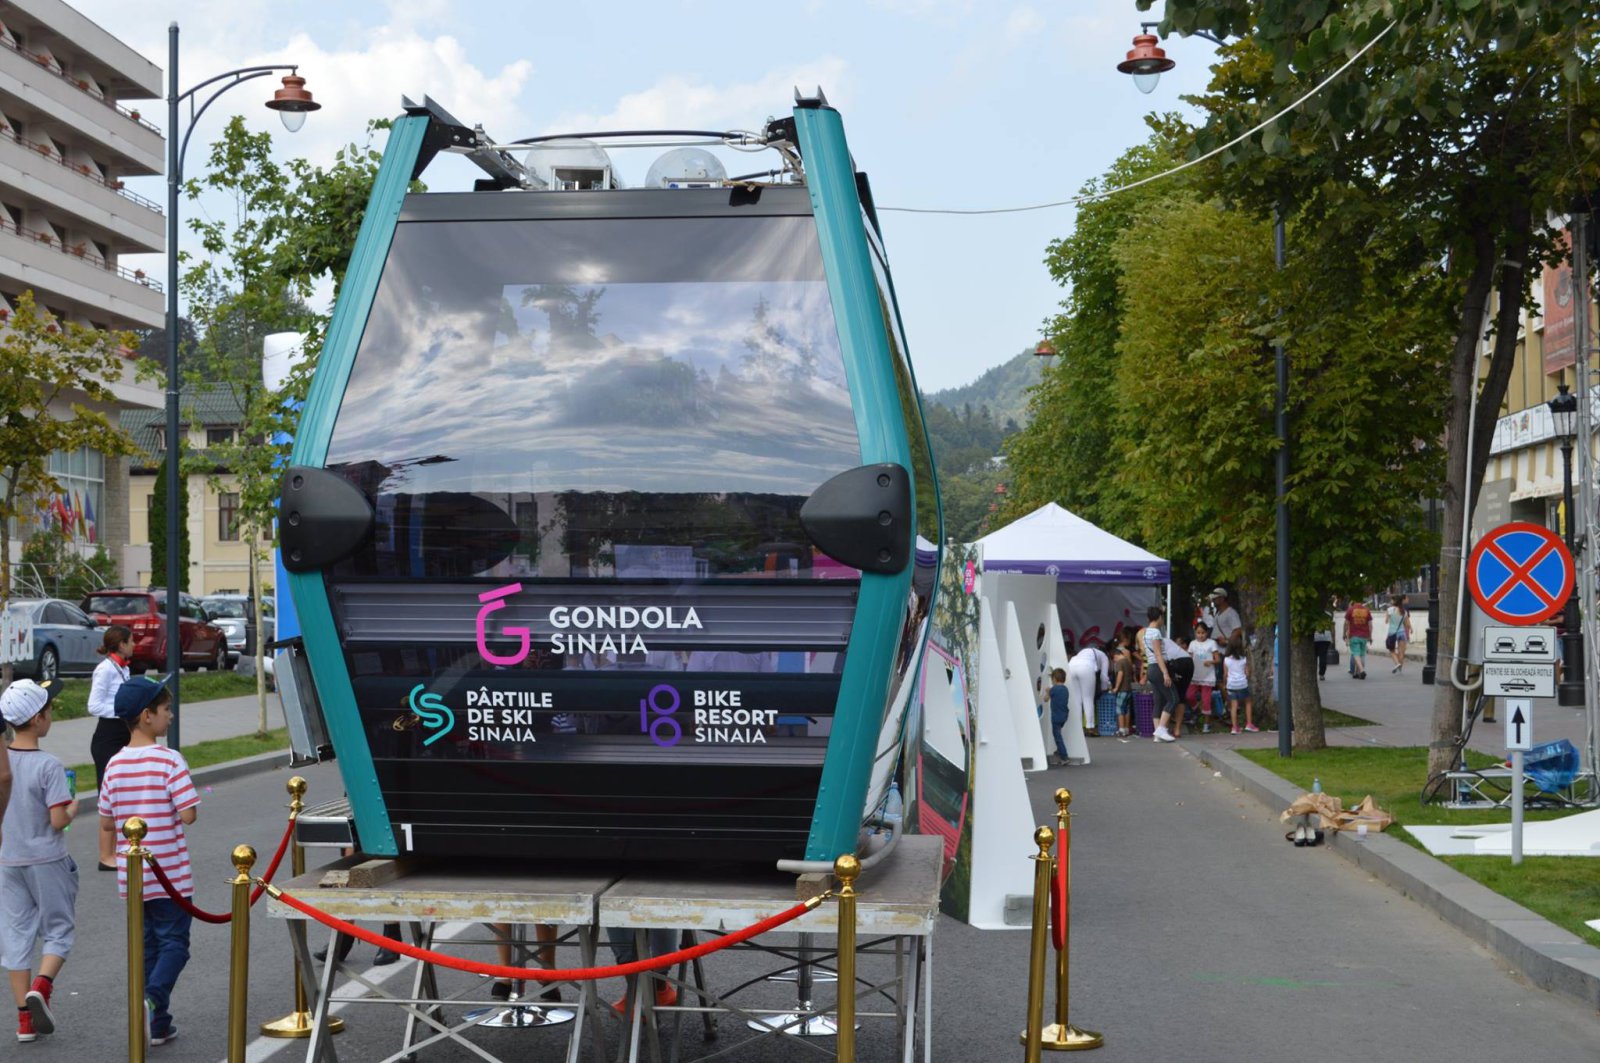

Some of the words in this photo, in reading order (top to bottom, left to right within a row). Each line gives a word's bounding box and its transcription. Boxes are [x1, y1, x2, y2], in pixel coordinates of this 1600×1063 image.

[549, 606, 703, 630] GONDOLA
[550, 633, 649, 655] SINAIA
[466, 686, 553, 708] PÂRTIILE
[694, 690, 742, 708] BIKE
[467, 708, 495, 725] DE
[501, 709, 533, 725] SKI
[694, 708, 779, 726] RESORT
[468, 726, 537, 743] SINAIA
[695, 727, 767, 744] SINAIA
[401, 823, 413, 851] 1
